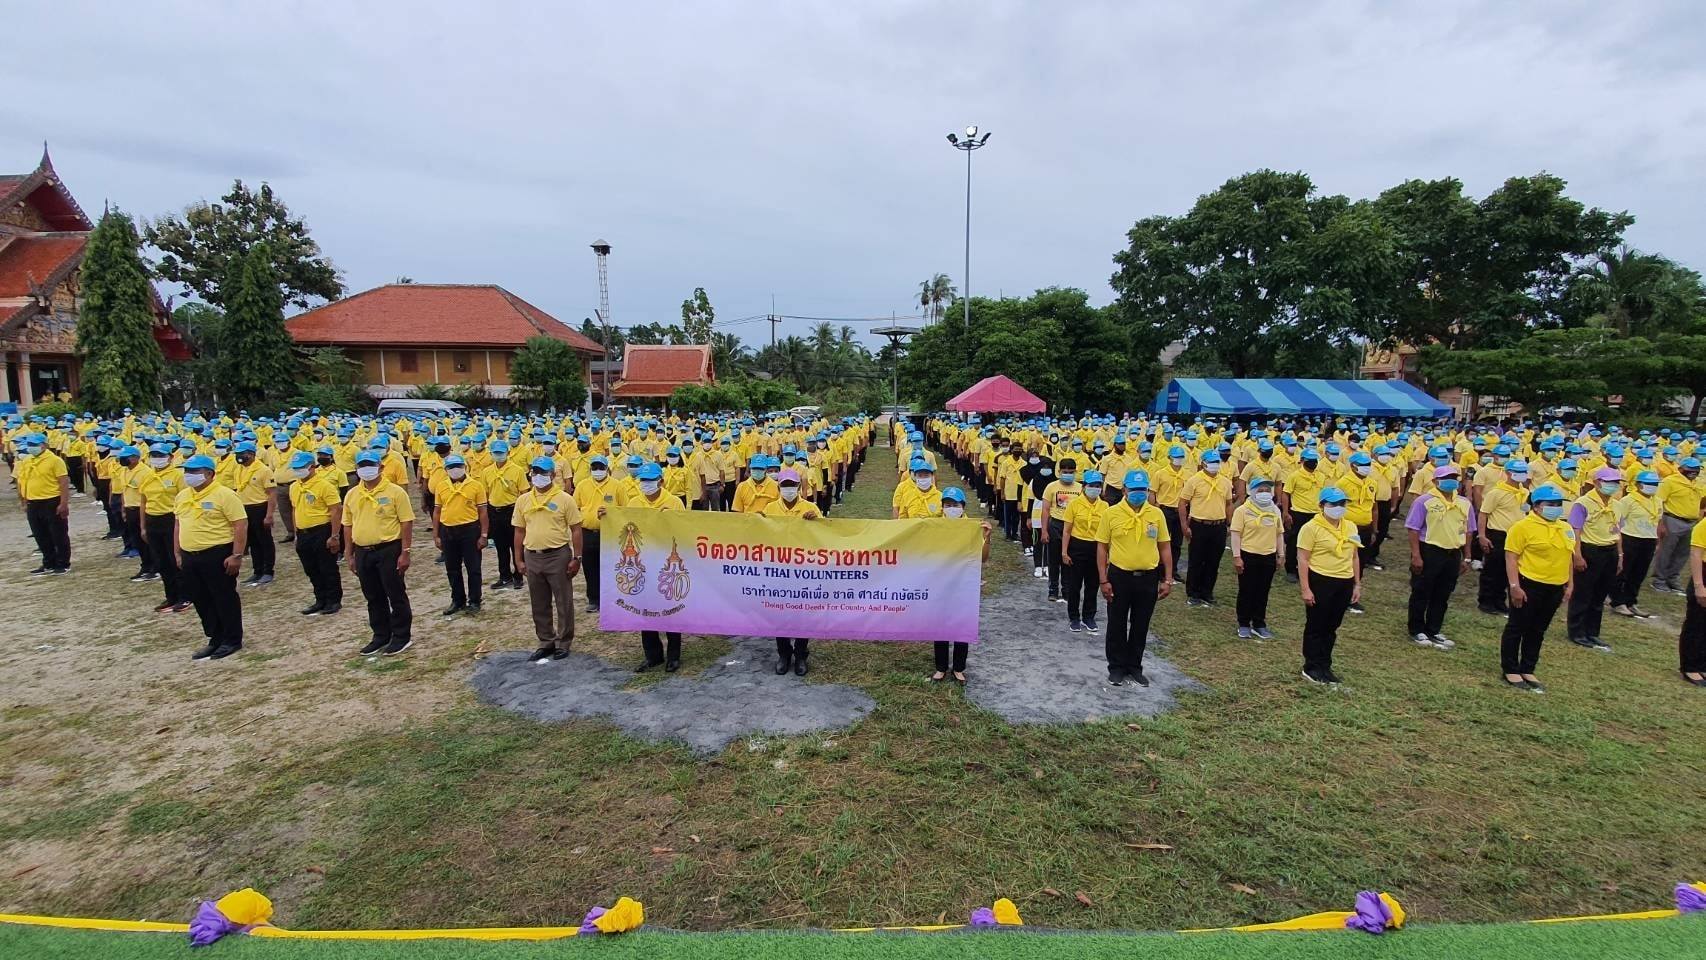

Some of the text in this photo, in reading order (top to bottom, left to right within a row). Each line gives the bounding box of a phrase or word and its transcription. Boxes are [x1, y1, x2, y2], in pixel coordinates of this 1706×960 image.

[723, 564, 869, 580] ROYAL THAI VOLUNTEERS
[833, 588, 854, 600] ชาติ
[785, 602, 803, 610] Good
[805, 603, 825, 611] Deeds
[827, 603, 838, 611] For
[840, 604, 866, 612] Country
[868, 604, 882, 612] And
